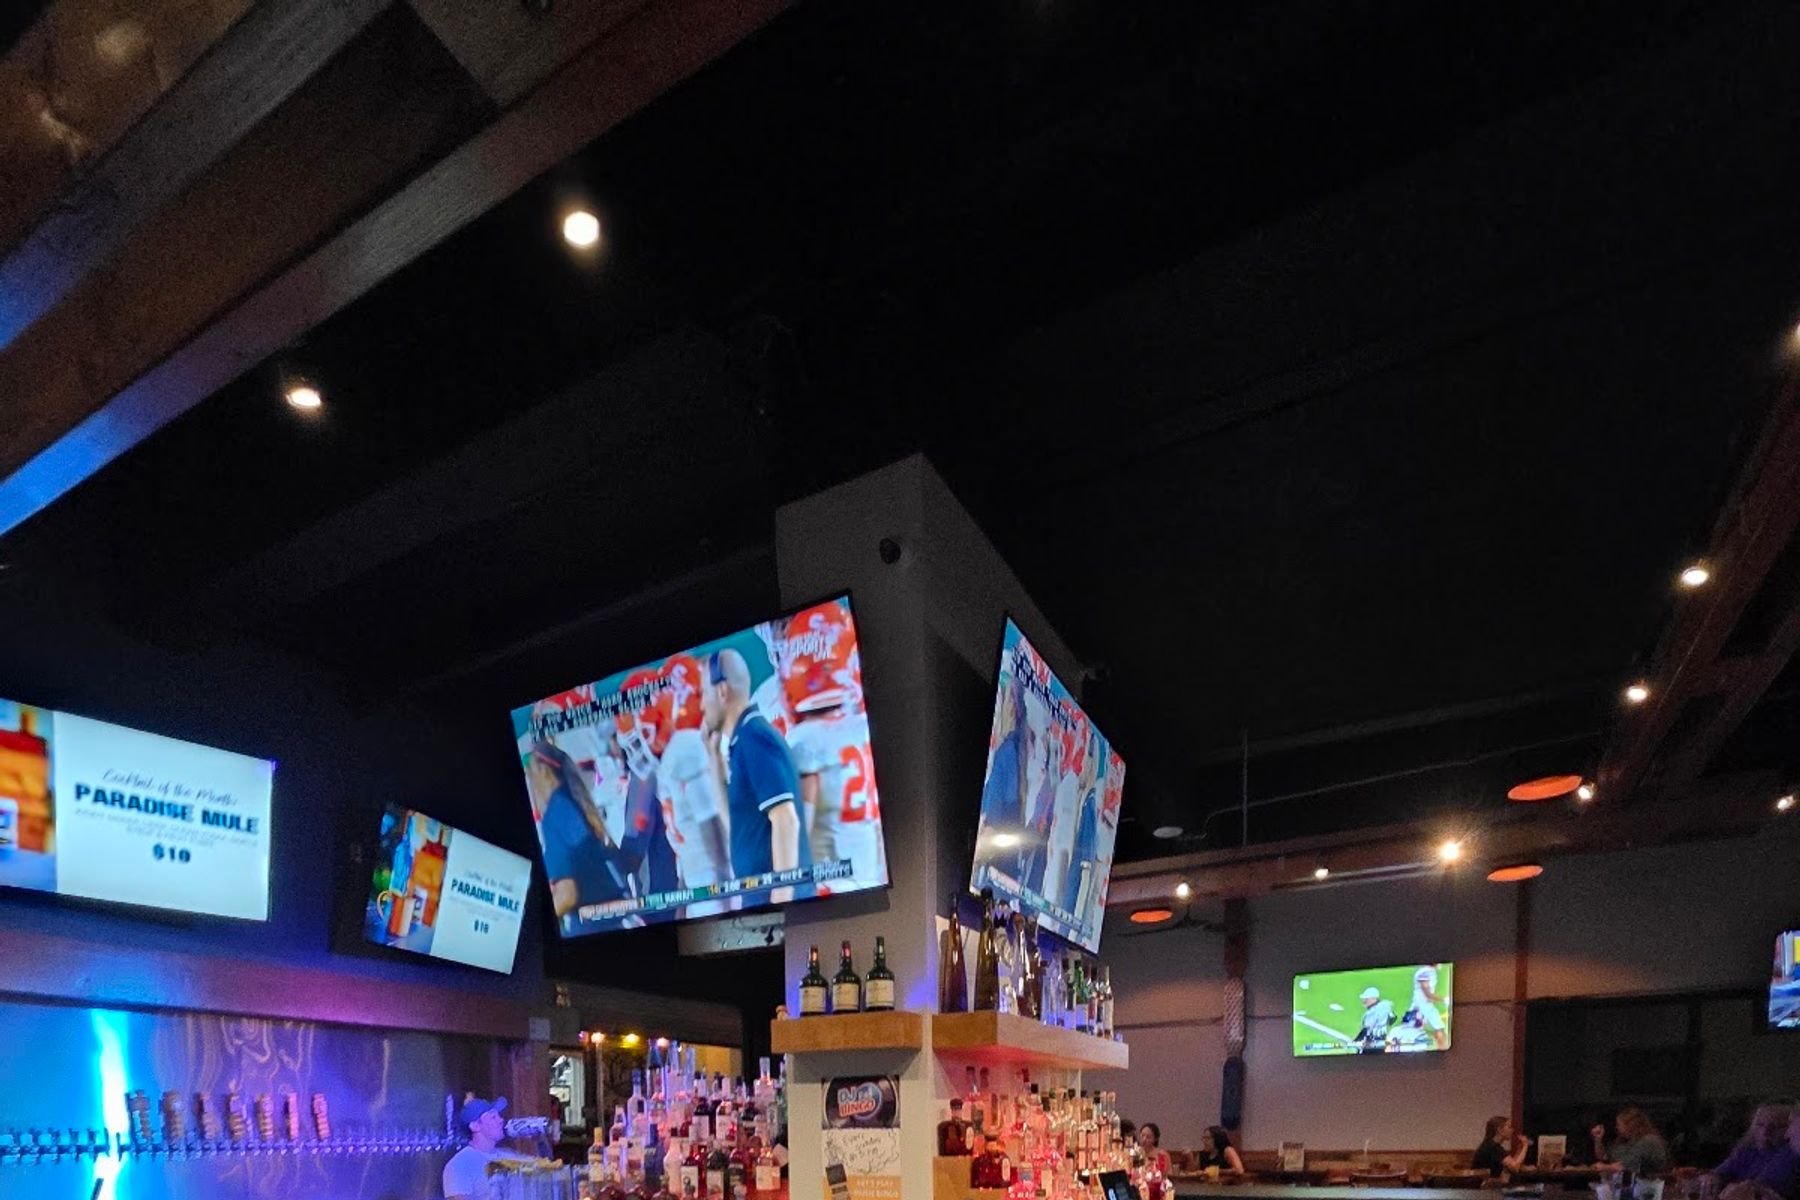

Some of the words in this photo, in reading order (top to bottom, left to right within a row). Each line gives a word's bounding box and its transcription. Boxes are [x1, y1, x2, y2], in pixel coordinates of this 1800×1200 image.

[74, 781, 195, 823] PARADISE
[201, 808, 259, 835] MULE
[152, 842, 191, 864] $10
[451, 878, 495, 905] PARADISE
[497, 893, 520, 912] MULE
